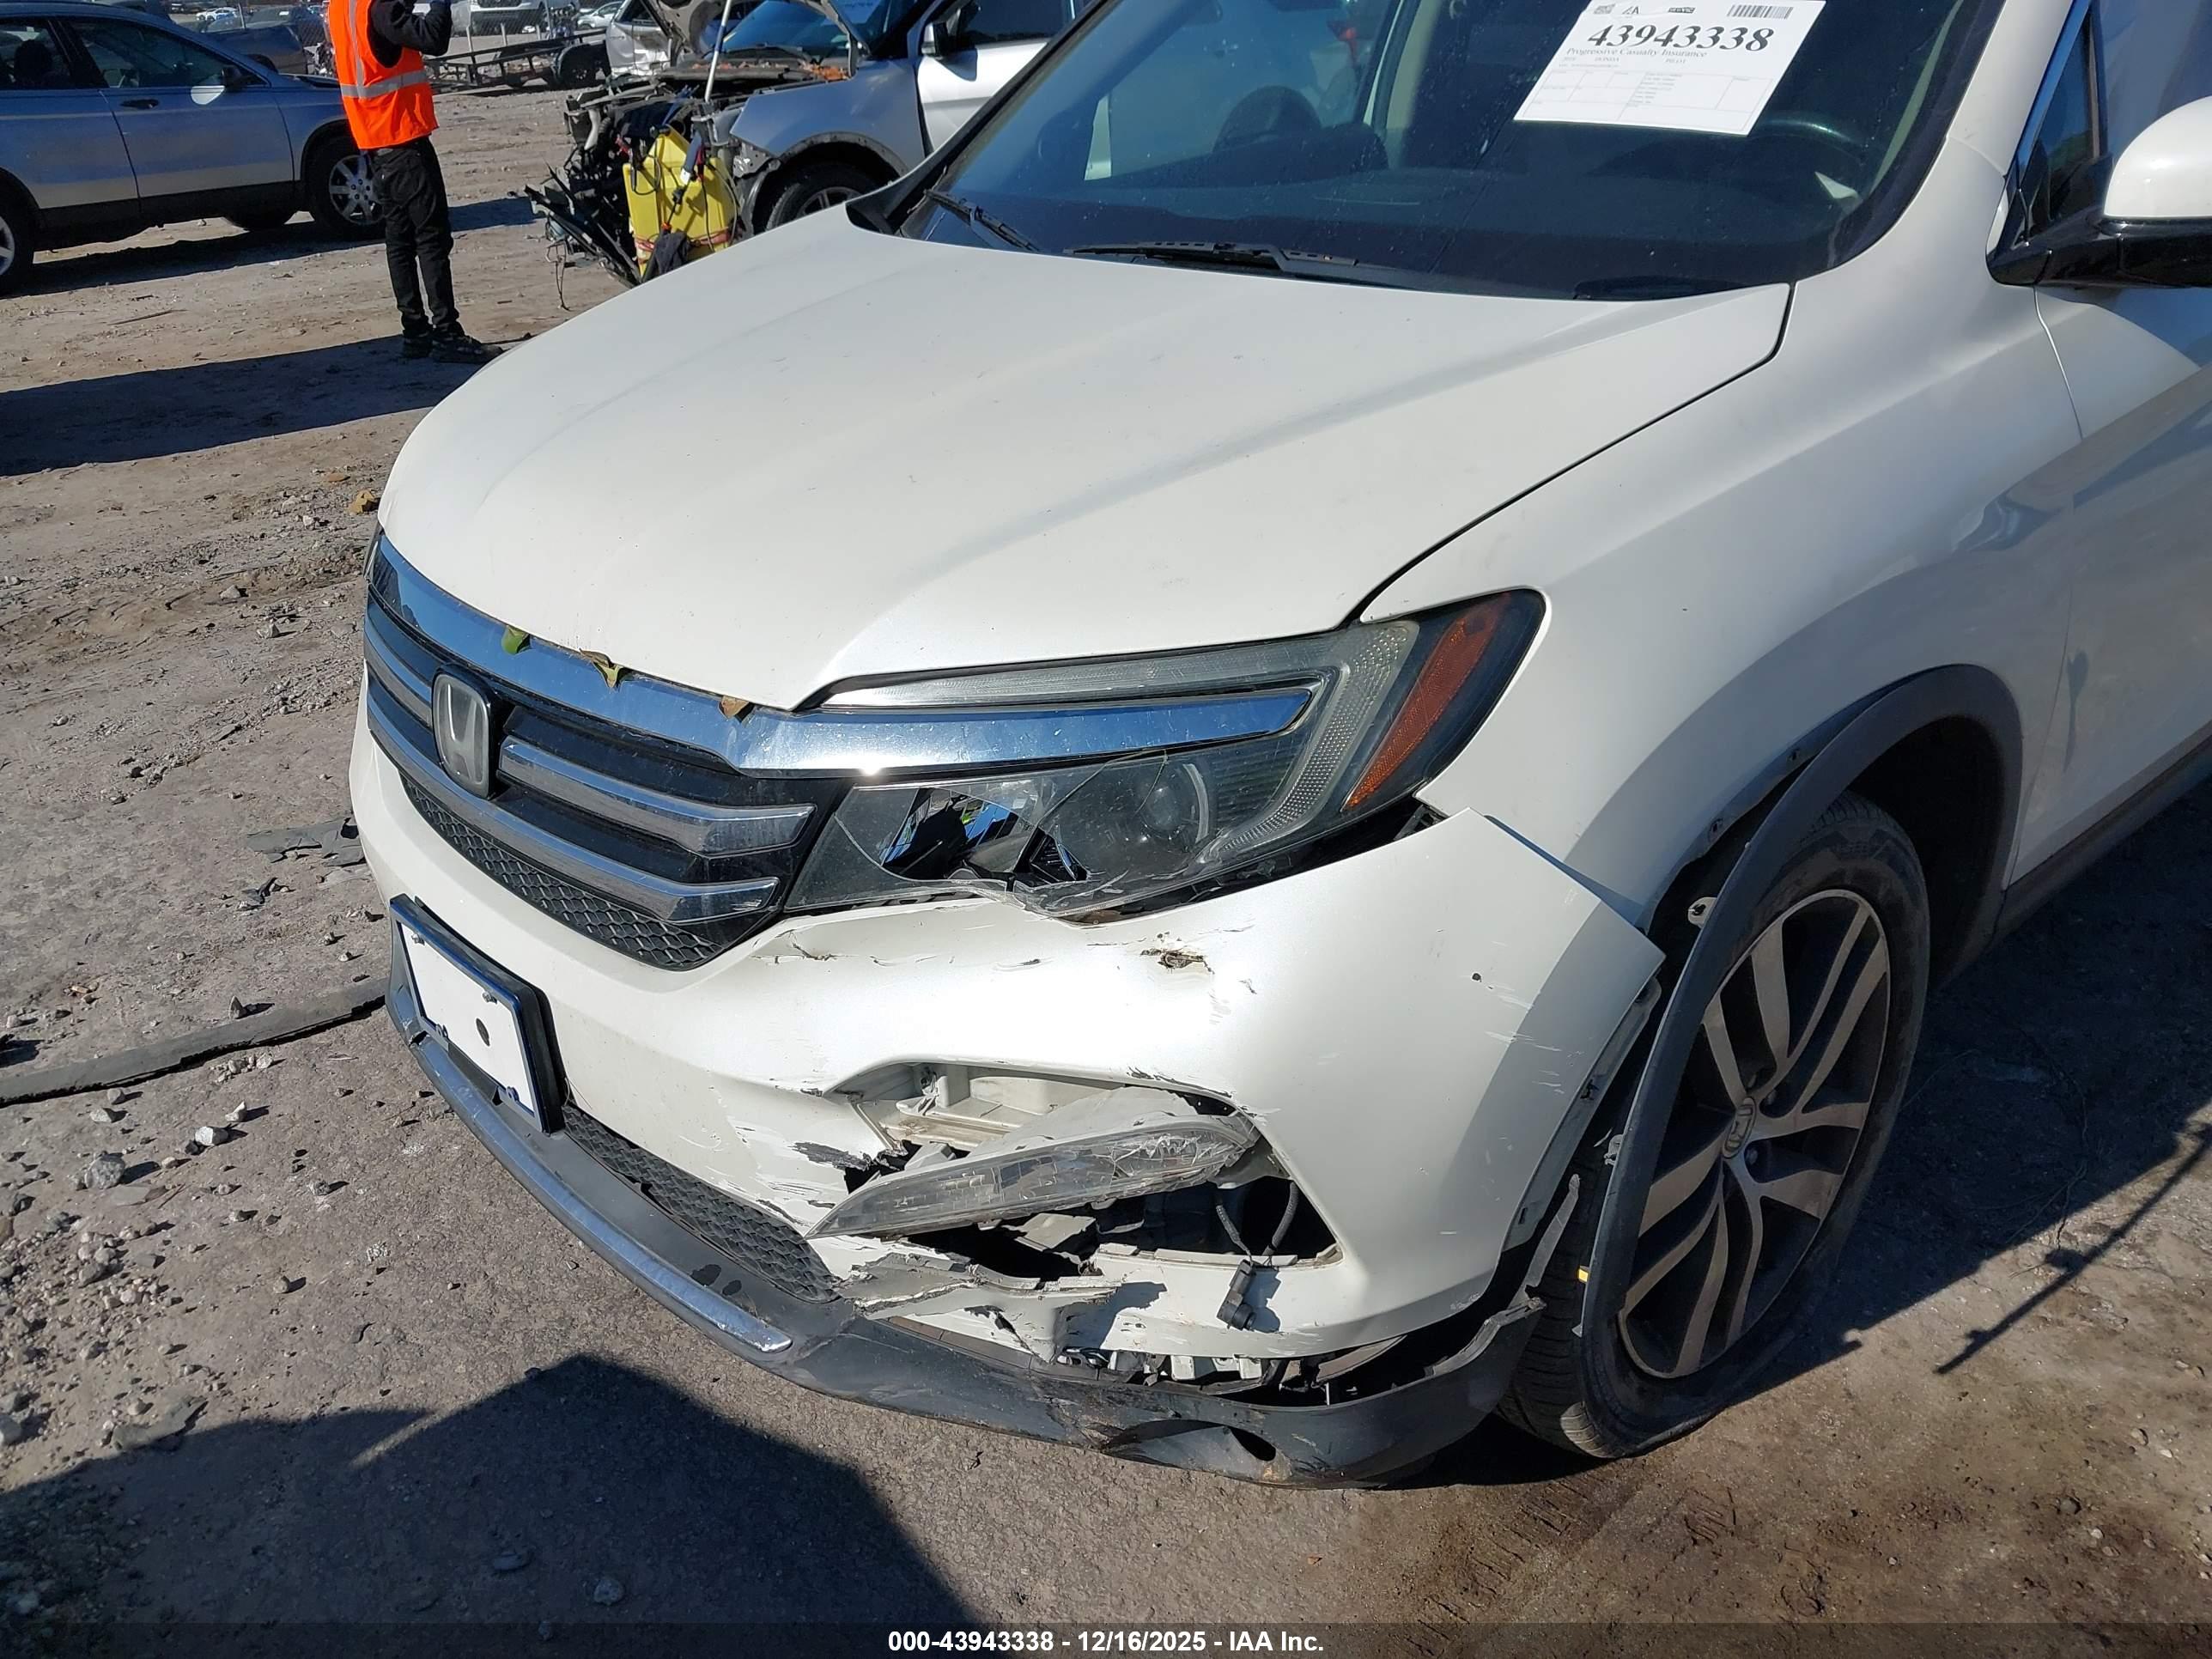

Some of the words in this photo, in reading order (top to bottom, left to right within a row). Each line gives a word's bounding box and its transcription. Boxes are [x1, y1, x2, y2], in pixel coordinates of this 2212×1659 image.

[1588, 23, 1774, 52] 43943338
[1566, 47, 1618, 57] Progressive
[1662, 49, 1708, 58] Insurance
